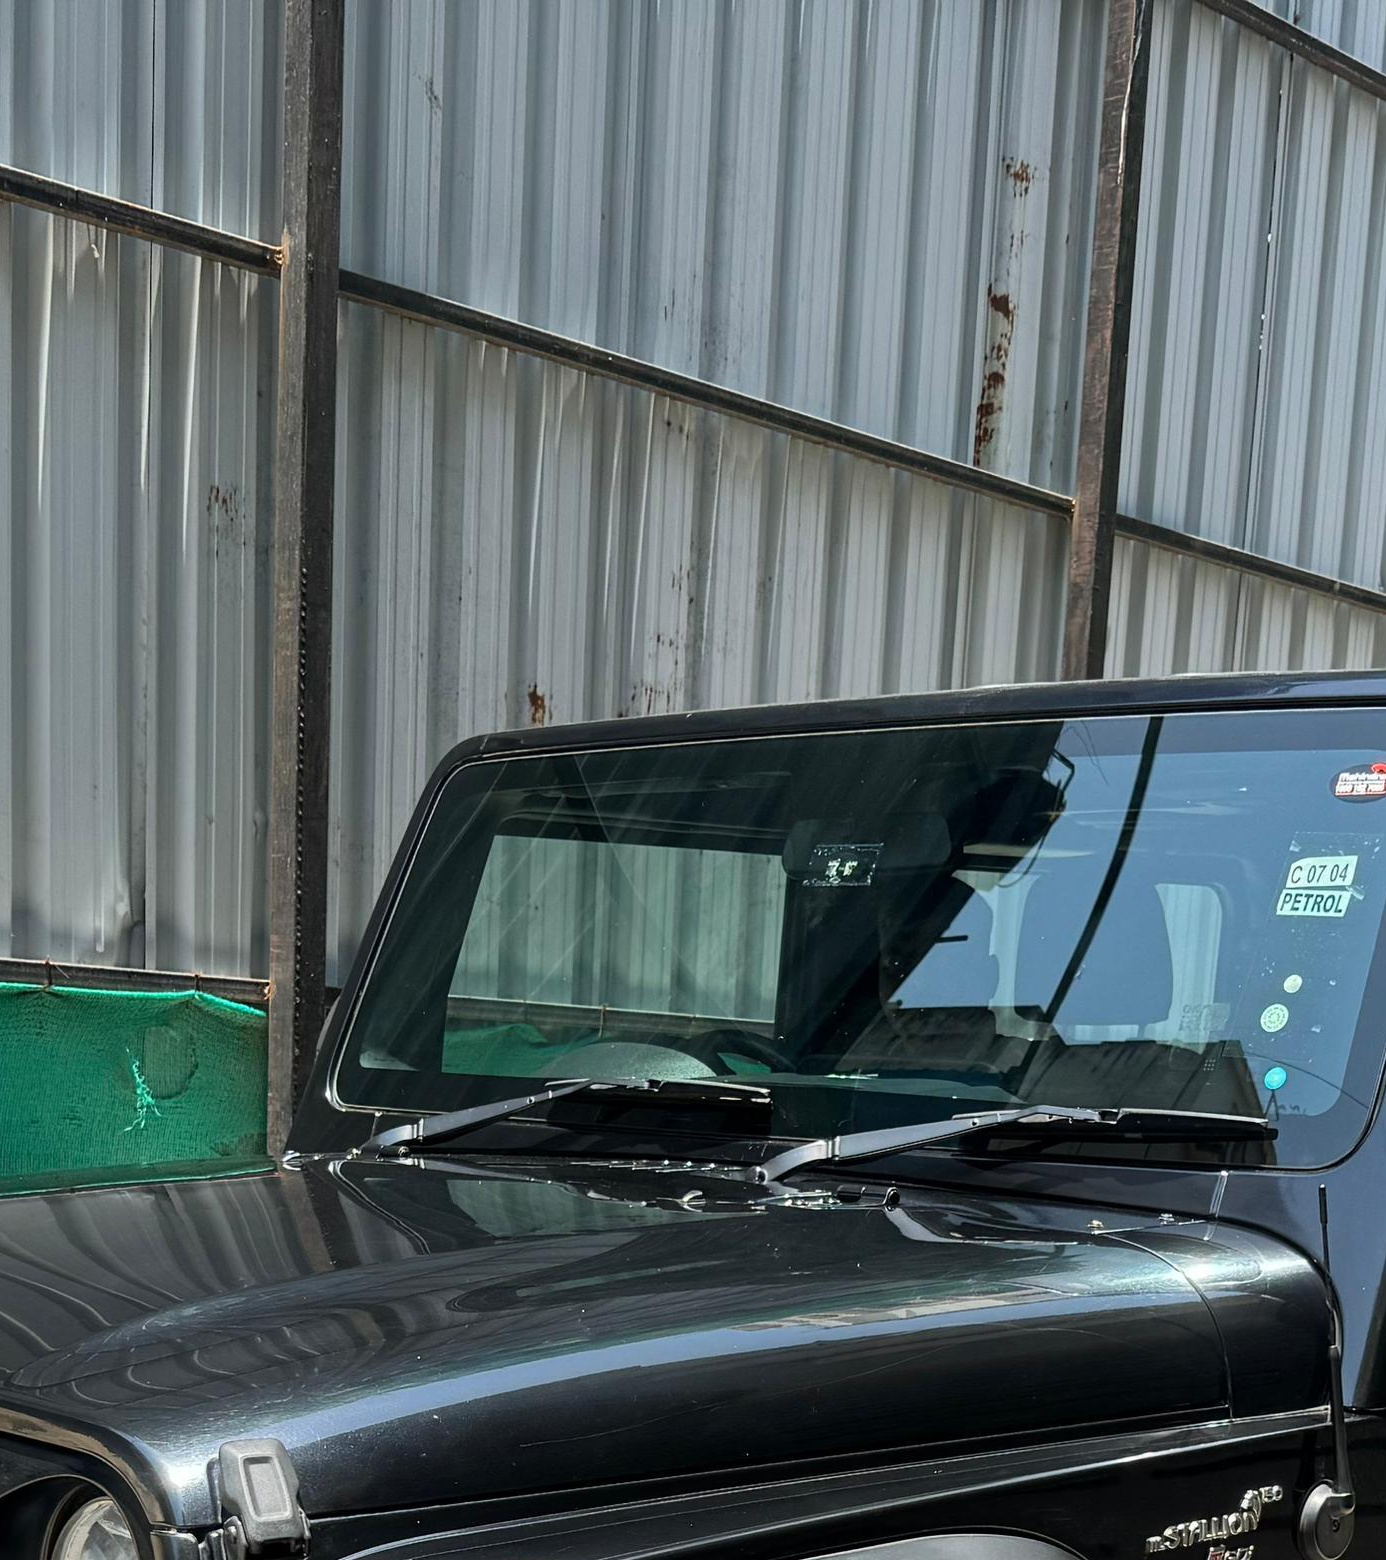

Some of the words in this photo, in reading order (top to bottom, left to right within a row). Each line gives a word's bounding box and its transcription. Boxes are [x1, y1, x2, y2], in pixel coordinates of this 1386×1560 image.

[1290, 865, 1303, 884] C
[1306, 864, 1326, 884] 07
[1329, 863, 1349, 883] 04
[1279, 892, 1344, 915] PETROL
